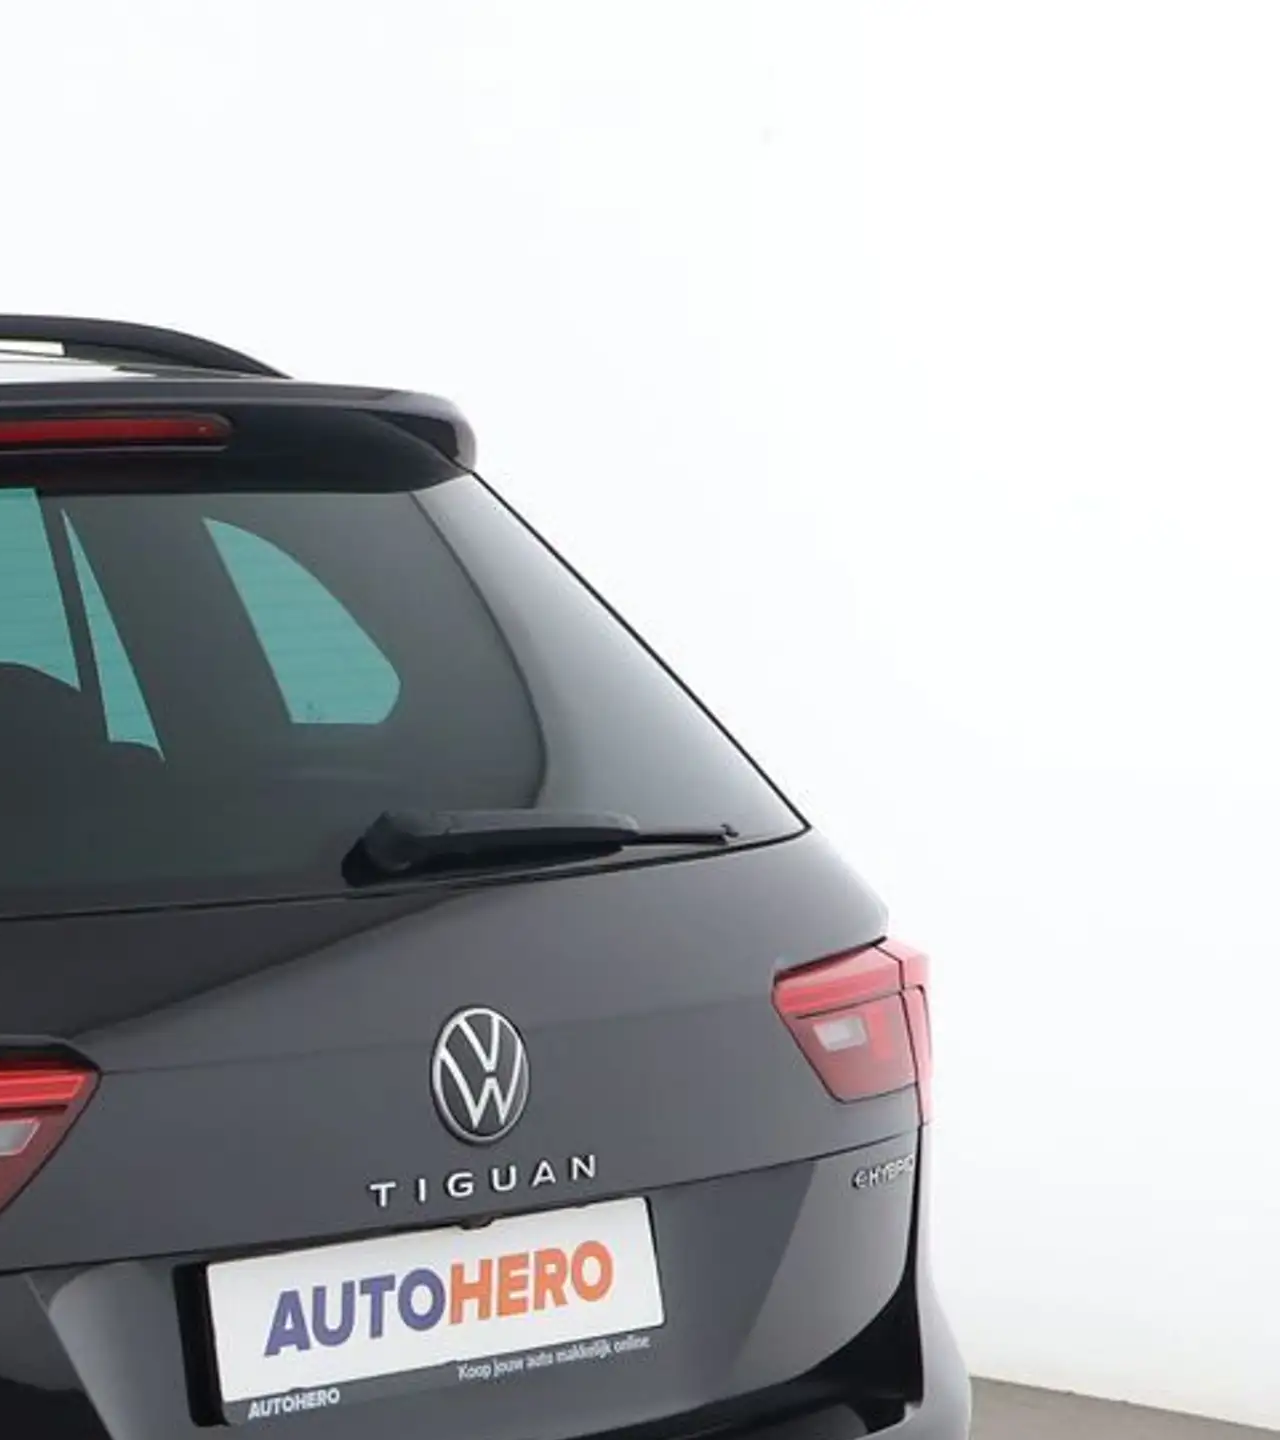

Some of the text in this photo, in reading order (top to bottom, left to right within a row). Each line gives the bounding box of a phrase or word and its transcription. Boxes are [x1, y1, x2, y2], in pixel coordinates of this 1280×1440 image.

[370, 1154, 598, 1208] TIGUAN
[264, 1240, 614, 1357] AUTOHERO
[457, 1363, 491, 1381] Koop
[526, 1351, 554, 1368] auto
[613, 1333, 651, 1353] online
[247, 1386, 341, 1420] AUTOHERO
